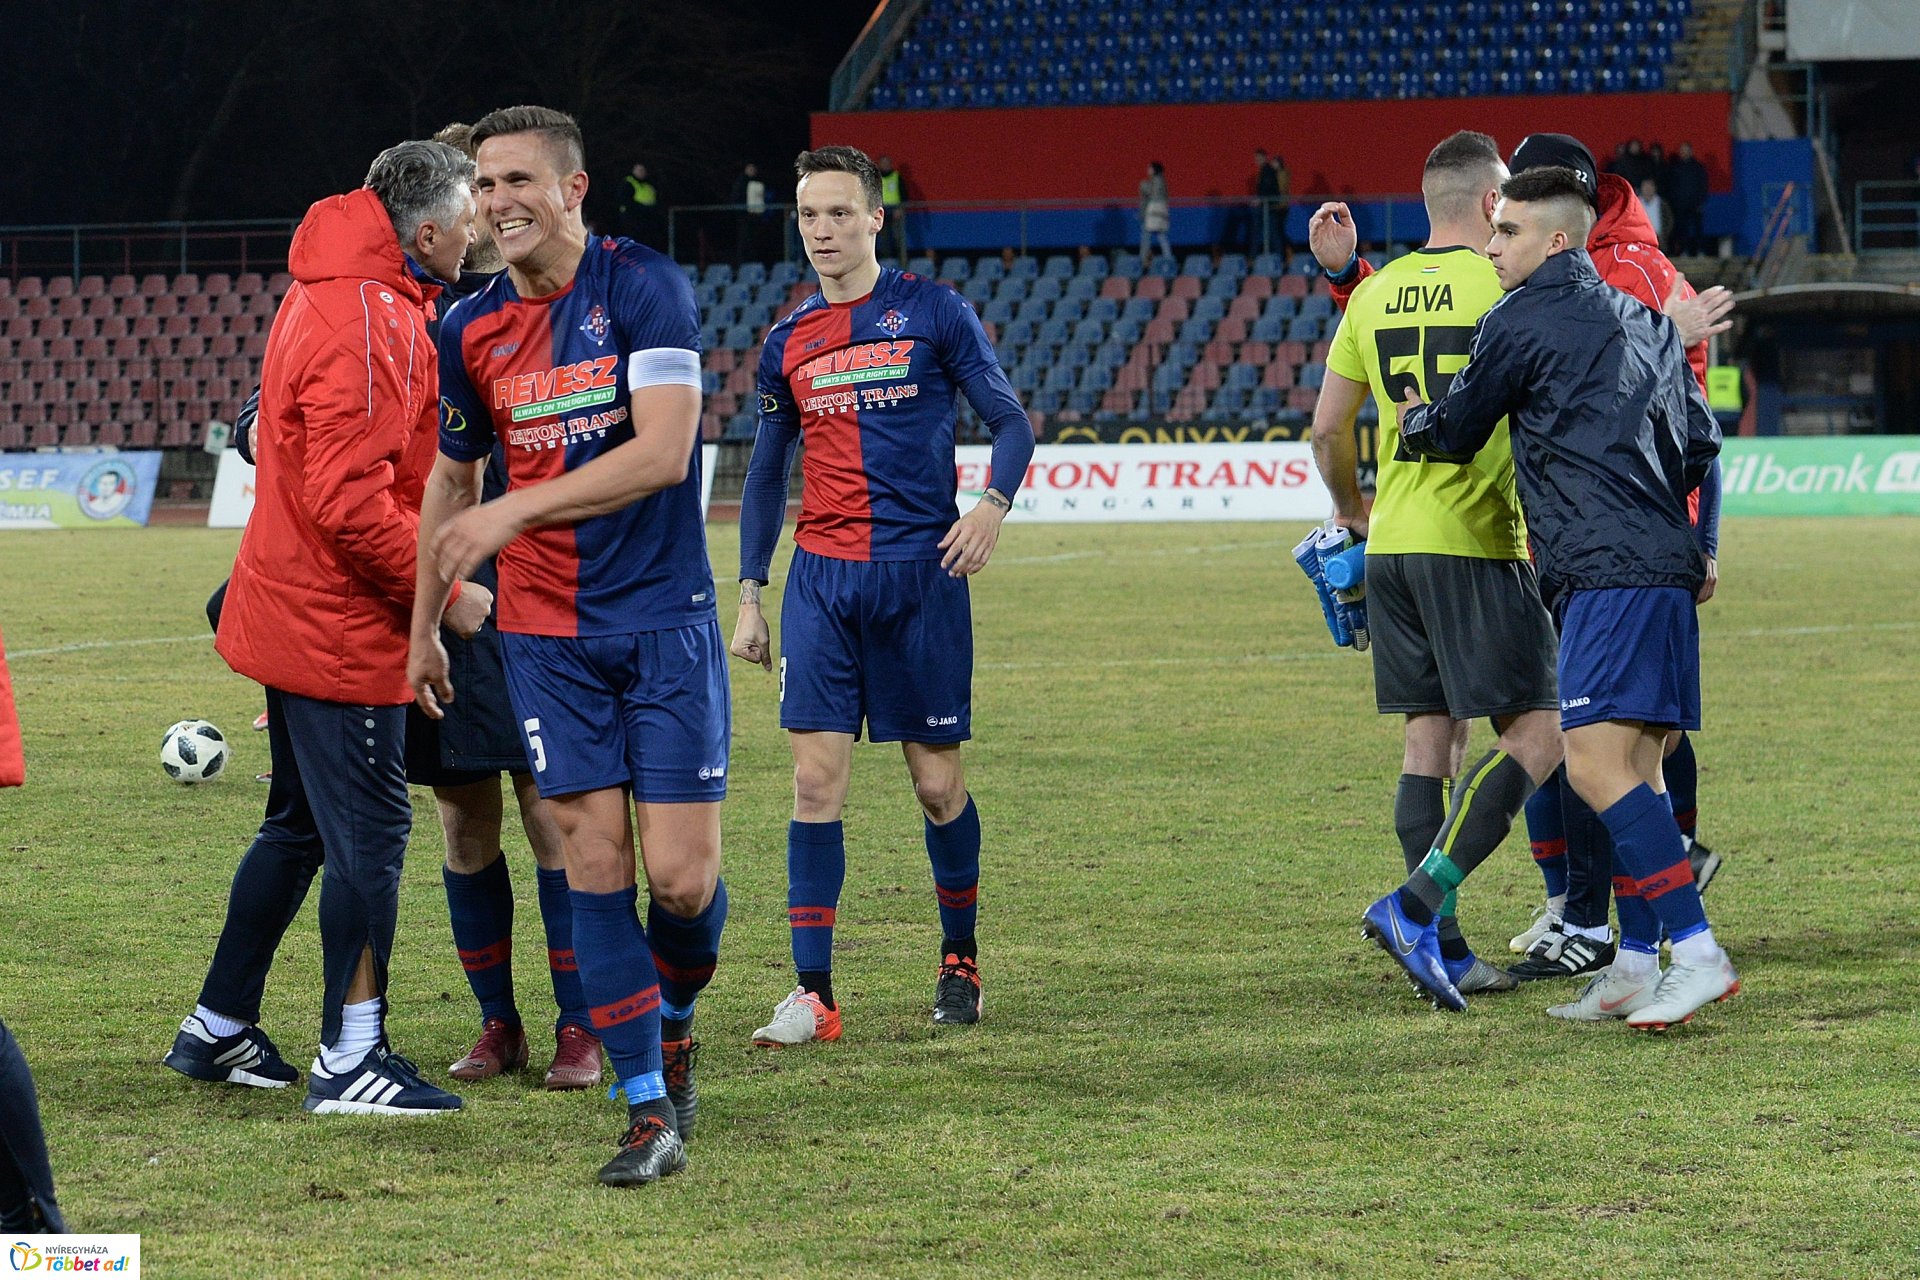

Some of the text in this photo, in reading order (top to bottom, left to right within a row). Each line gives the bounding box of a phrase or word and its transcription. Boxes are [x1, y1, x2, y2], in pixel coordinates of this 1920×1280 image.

[1385, 284, 1454, 315] JOVA
[814, 376, 840, 387] ALWAYS
[840, 374, 851, 382] ON
[866, 370, 888, 379] RIGHT
[889, 368, 906, 376] WAY
[514, 405, 542, 418] ALWAYS
[543, 403, 555, 412] ON
[593, 390, 614, 401] WAY
[860, 384, 919, 403] TRANS
[1137, 459, 1310, 490] TRANS
[1568, 696, 1591, 708] JAKO
[938, 715, 958, 726] JAKO
[524, 717, 547, 773] 5
